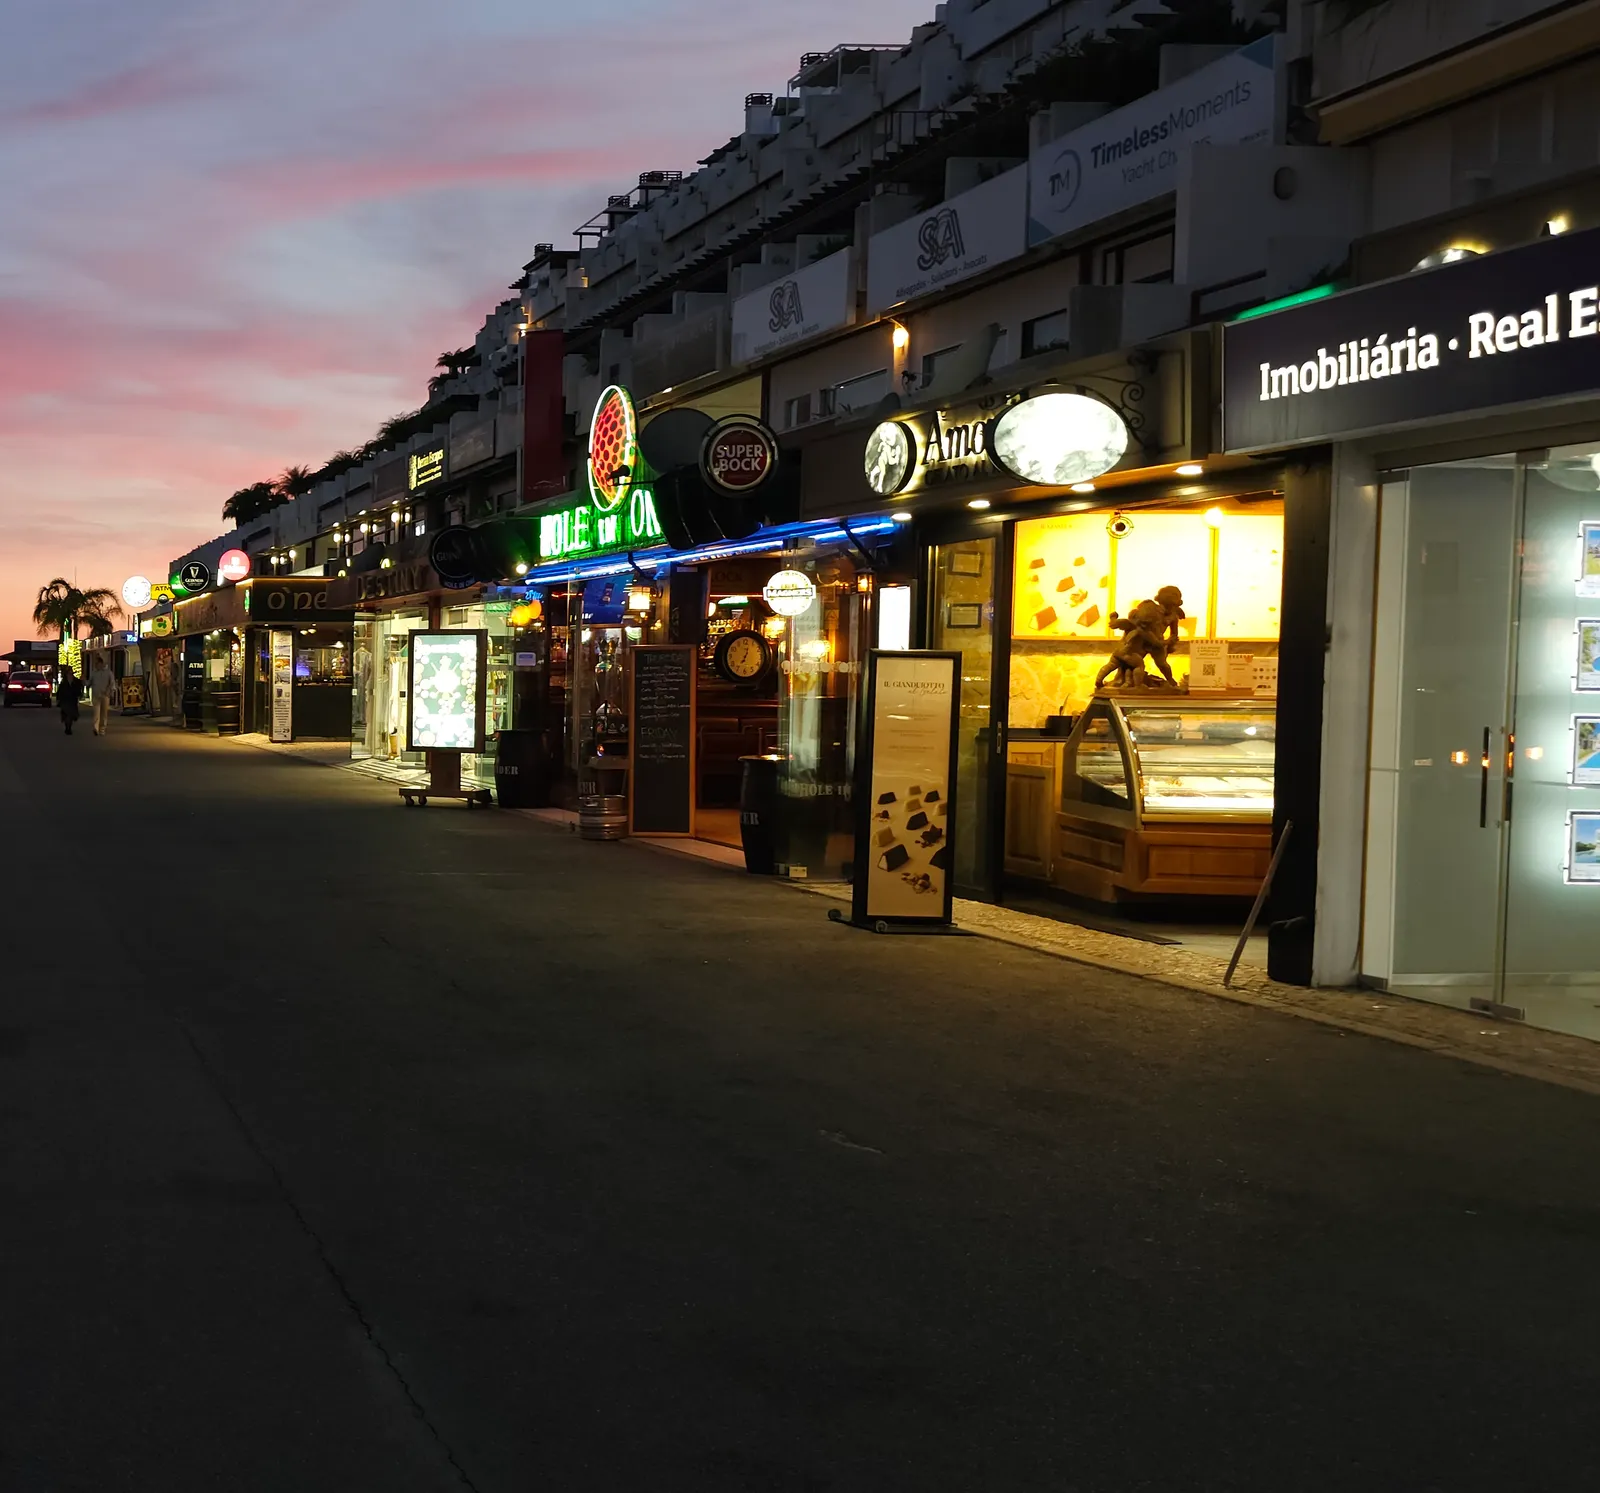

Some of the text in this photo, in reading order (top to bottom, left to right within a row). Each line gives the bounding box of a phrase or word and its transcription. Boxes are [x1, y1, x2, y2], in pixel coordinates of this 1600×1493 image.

[1091, 80, 1252, 168] TimelessMoments
[1049, 169, 1071, 196] TM
[1122, 157, 1155, 184] Yacht
[1259, 326, 1440, 401] Imobiliária
[1467, 292, 1560, 360] Real
[1567, 285, 1600, 339] E
[716, 444, 764, 459] SUPER
[718, 457, 762, 472] BOCK
[540, 506, 591, 557] HOLE
[597, 514, 618, 545] IN
[357, 565, 422, 600] DESTINY
